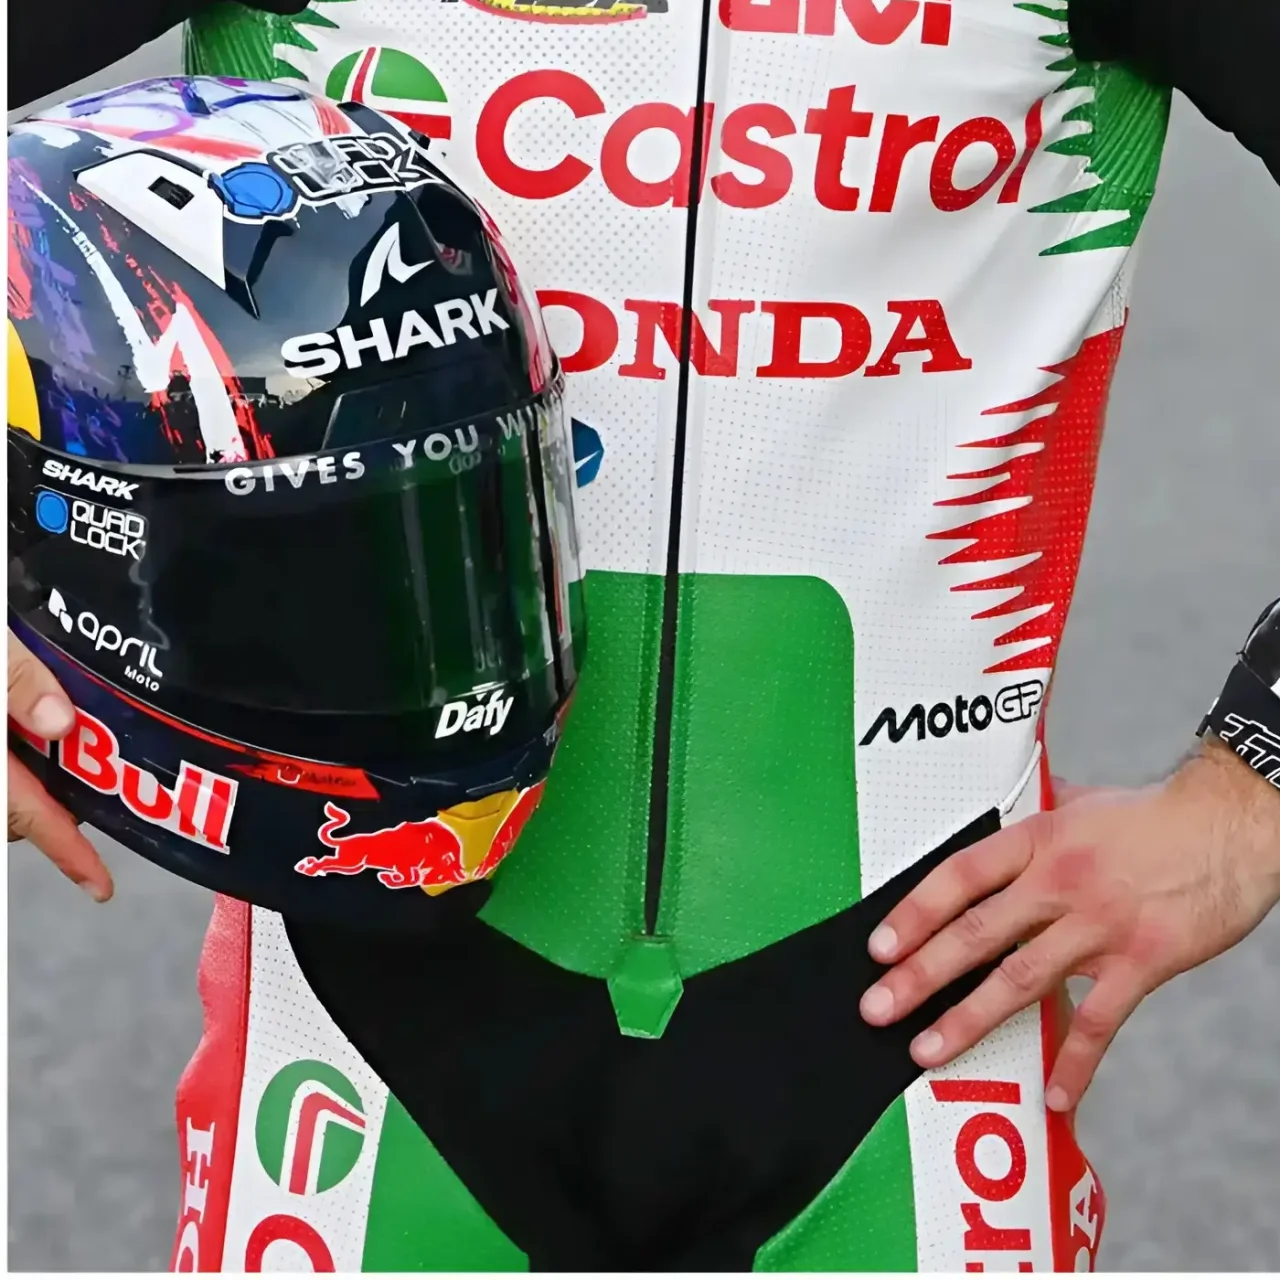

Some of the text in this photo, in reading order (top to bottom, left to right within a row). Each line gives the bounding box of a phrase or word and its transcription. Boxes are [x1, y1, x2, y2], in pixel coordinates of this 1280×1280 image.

[475, 68, 1043, 213] Castrol
[281, 288, 511, 380] SHARK
[533, 289, 973, 381] ONDA
[42, 459, 140, 501] SHARK
[225, 451, 366, 495] GIVES
[391, 424, 480, 468] YOU
[70, 520, 145, 561] LOCK
[72, 500, 145, 538] QUAD
[124, 665, 160, 692] Moto
[434, 688, 515, 739] Dafy
[59, 705, 239, 855] Bull
